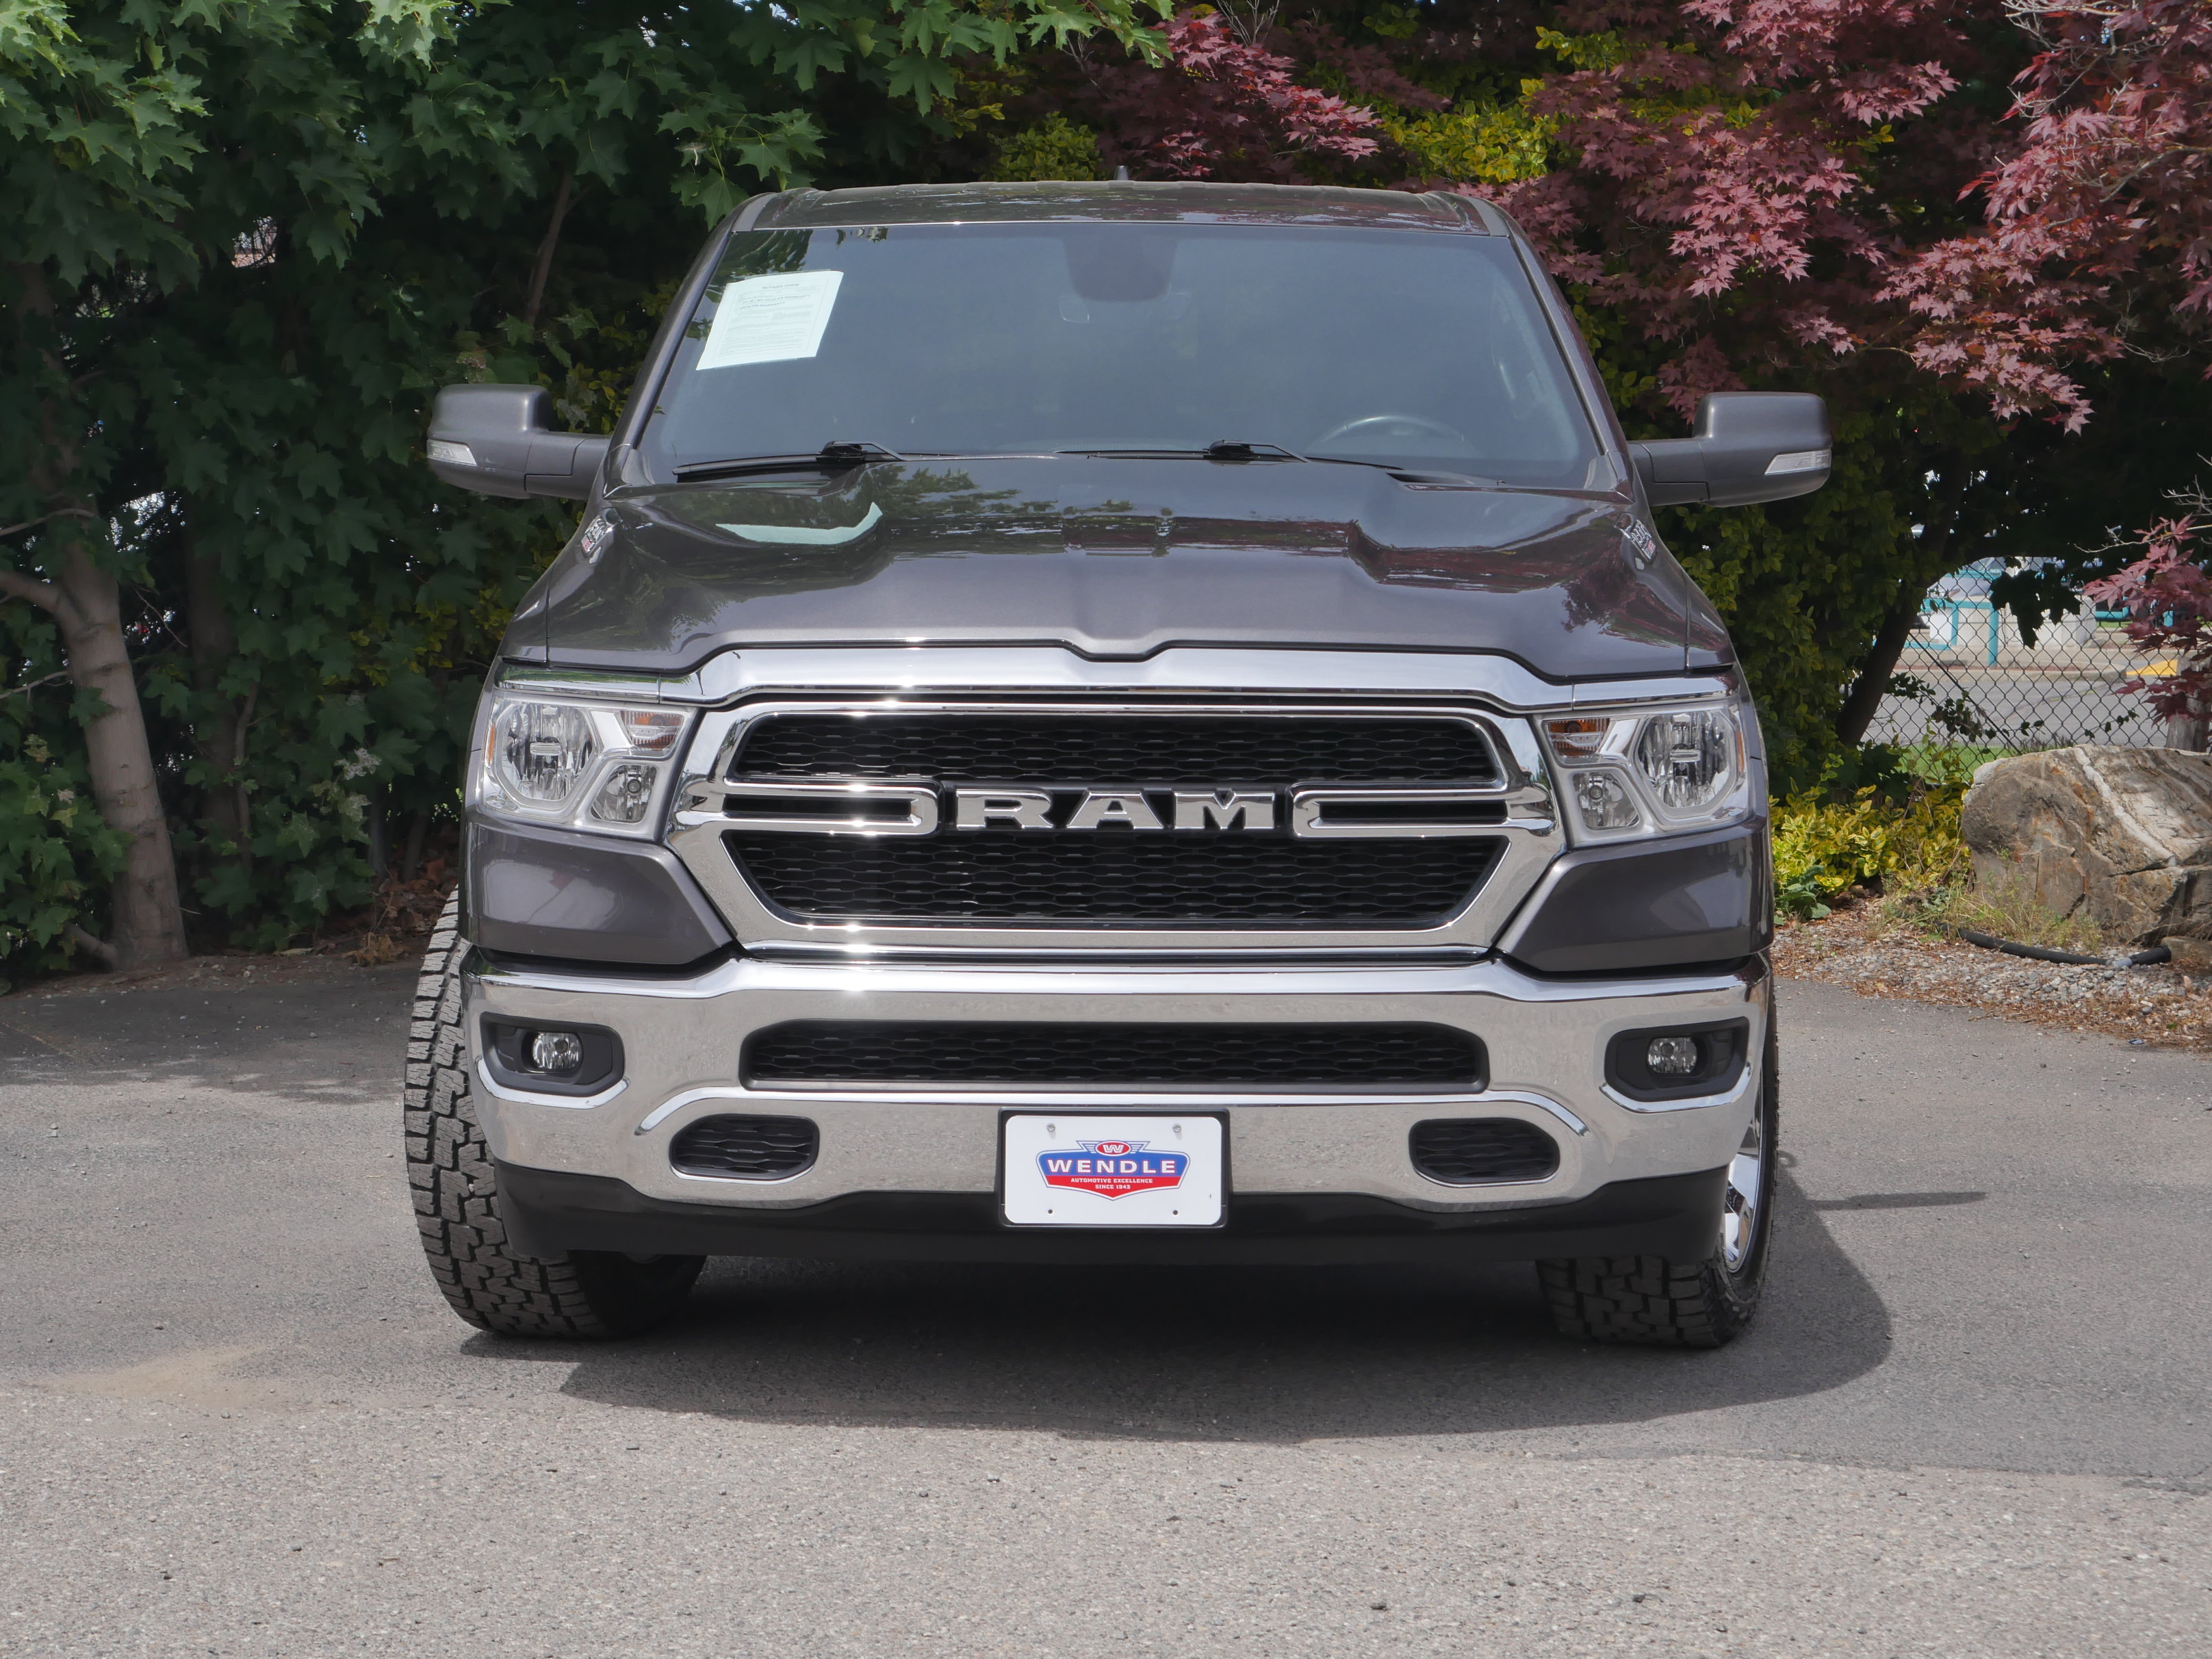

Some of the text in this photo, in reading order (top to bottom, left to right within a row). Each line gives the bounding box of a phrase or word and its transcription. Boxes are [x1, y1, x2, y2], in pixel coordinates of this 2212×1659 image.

[955, 789, 1275, 830] RAM
[1102, 1144, 1124, 1154] W
[1046, 1159, 1176, 1174] WENDLE
